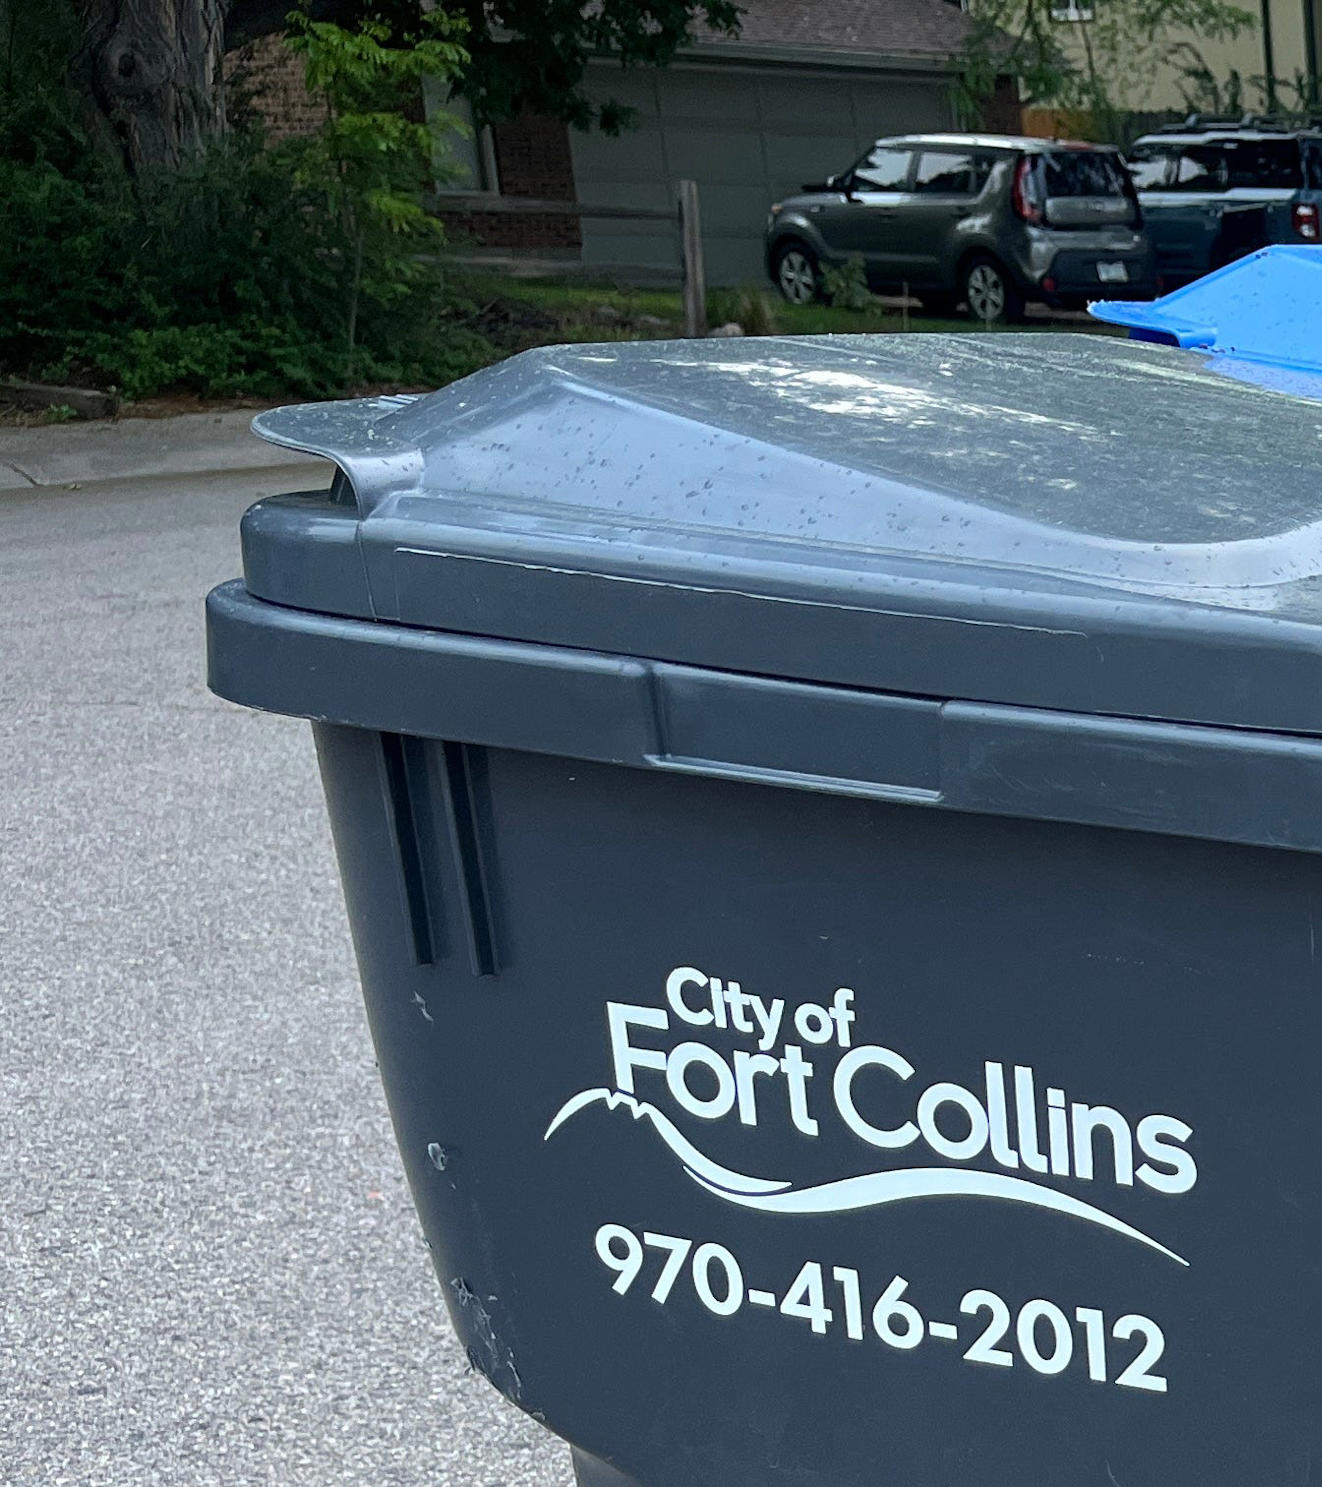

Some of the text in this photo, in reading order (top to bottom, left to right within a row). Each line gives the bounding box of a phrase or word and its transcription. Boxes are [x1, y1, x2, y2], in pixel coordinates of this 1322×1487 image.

[665, 966, 856, 1052] City of
[606, 1001, 1198, 1194] Fort Collins
[595, 1223, 1169, 1393] 970-416-2012
